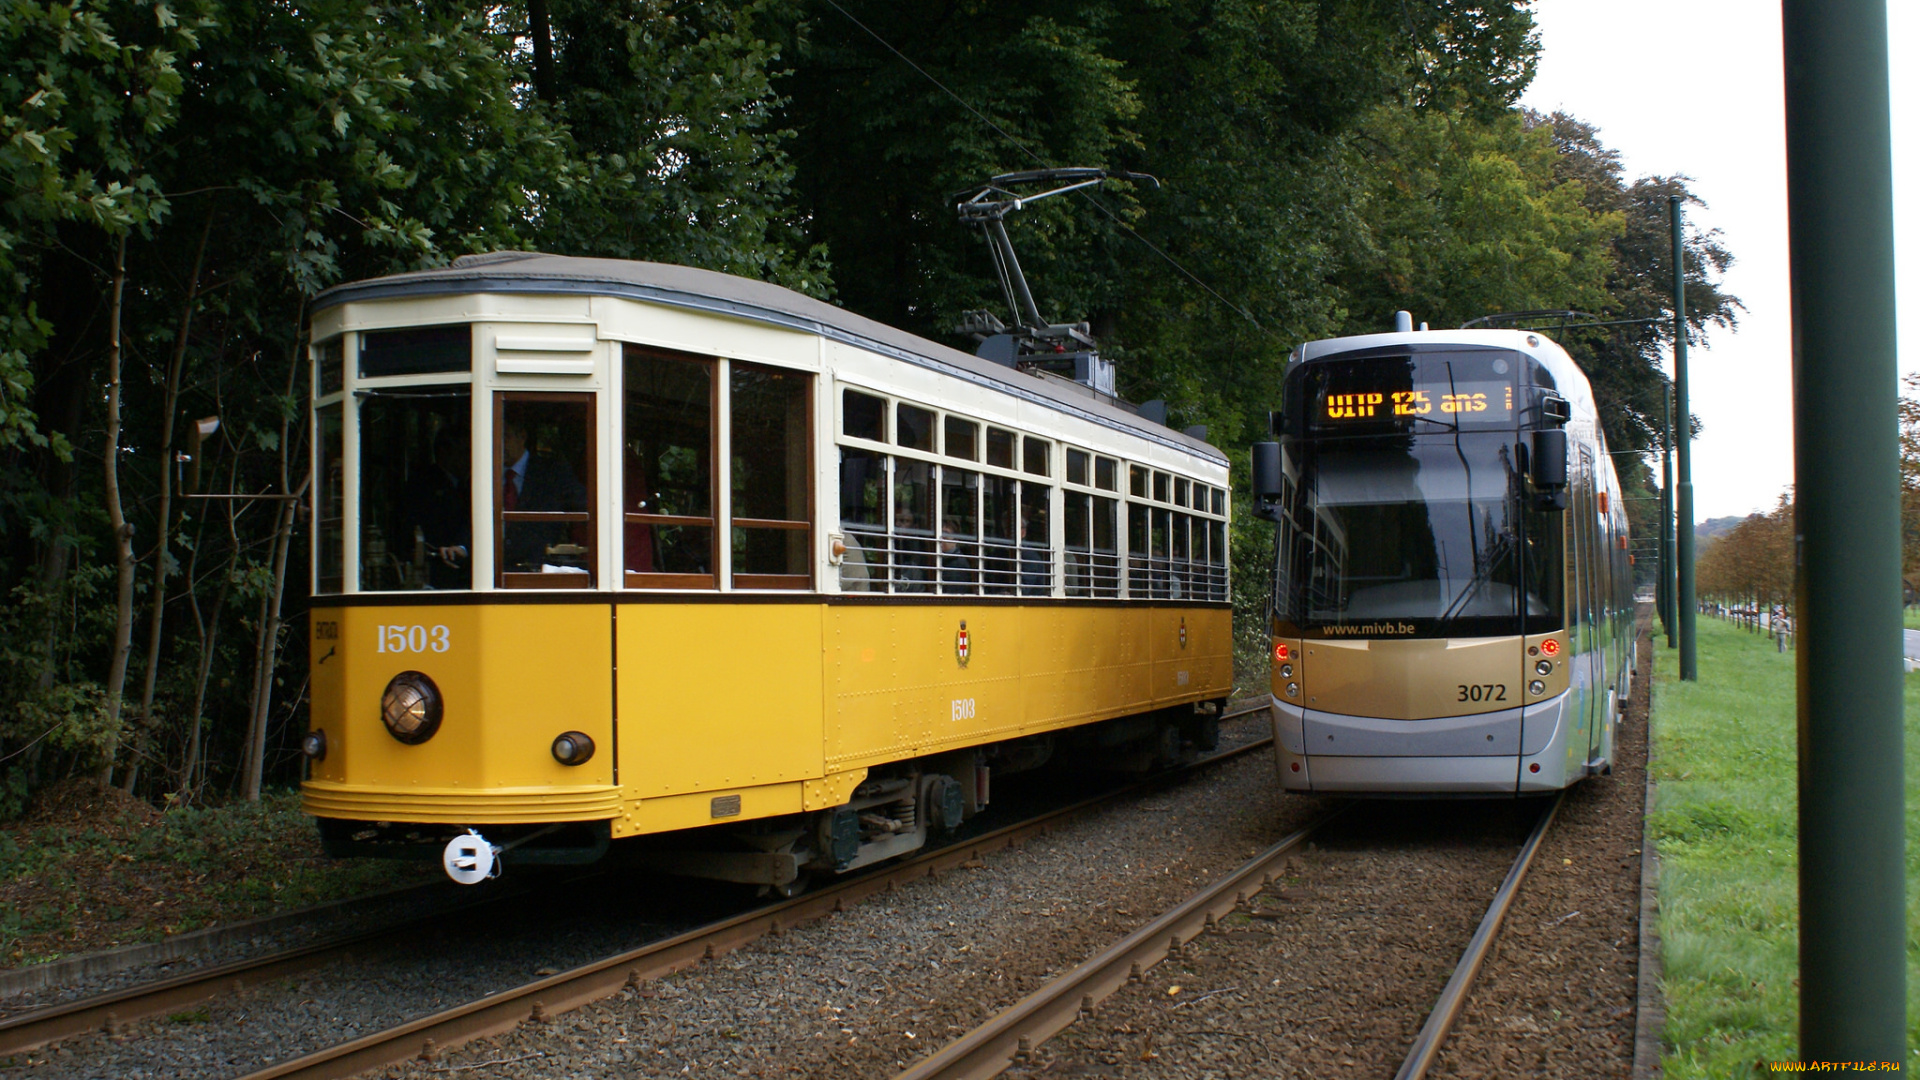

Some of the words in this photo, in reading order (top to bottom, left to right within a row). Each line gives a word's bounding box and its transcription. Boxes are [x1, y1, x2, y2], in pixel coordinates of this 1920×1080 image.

[1327, 393, 1383, 419] UITP
[1391, 390, 1432, 416] 125
[1440, 393, 1488, 413] ans
[377, 624, 451, 653] 1503
[1322, 622, 1415, 636] www.mivb.be
[1457, 684, 1507, 702] 3072
[951, 698, 976, 722] 1503
